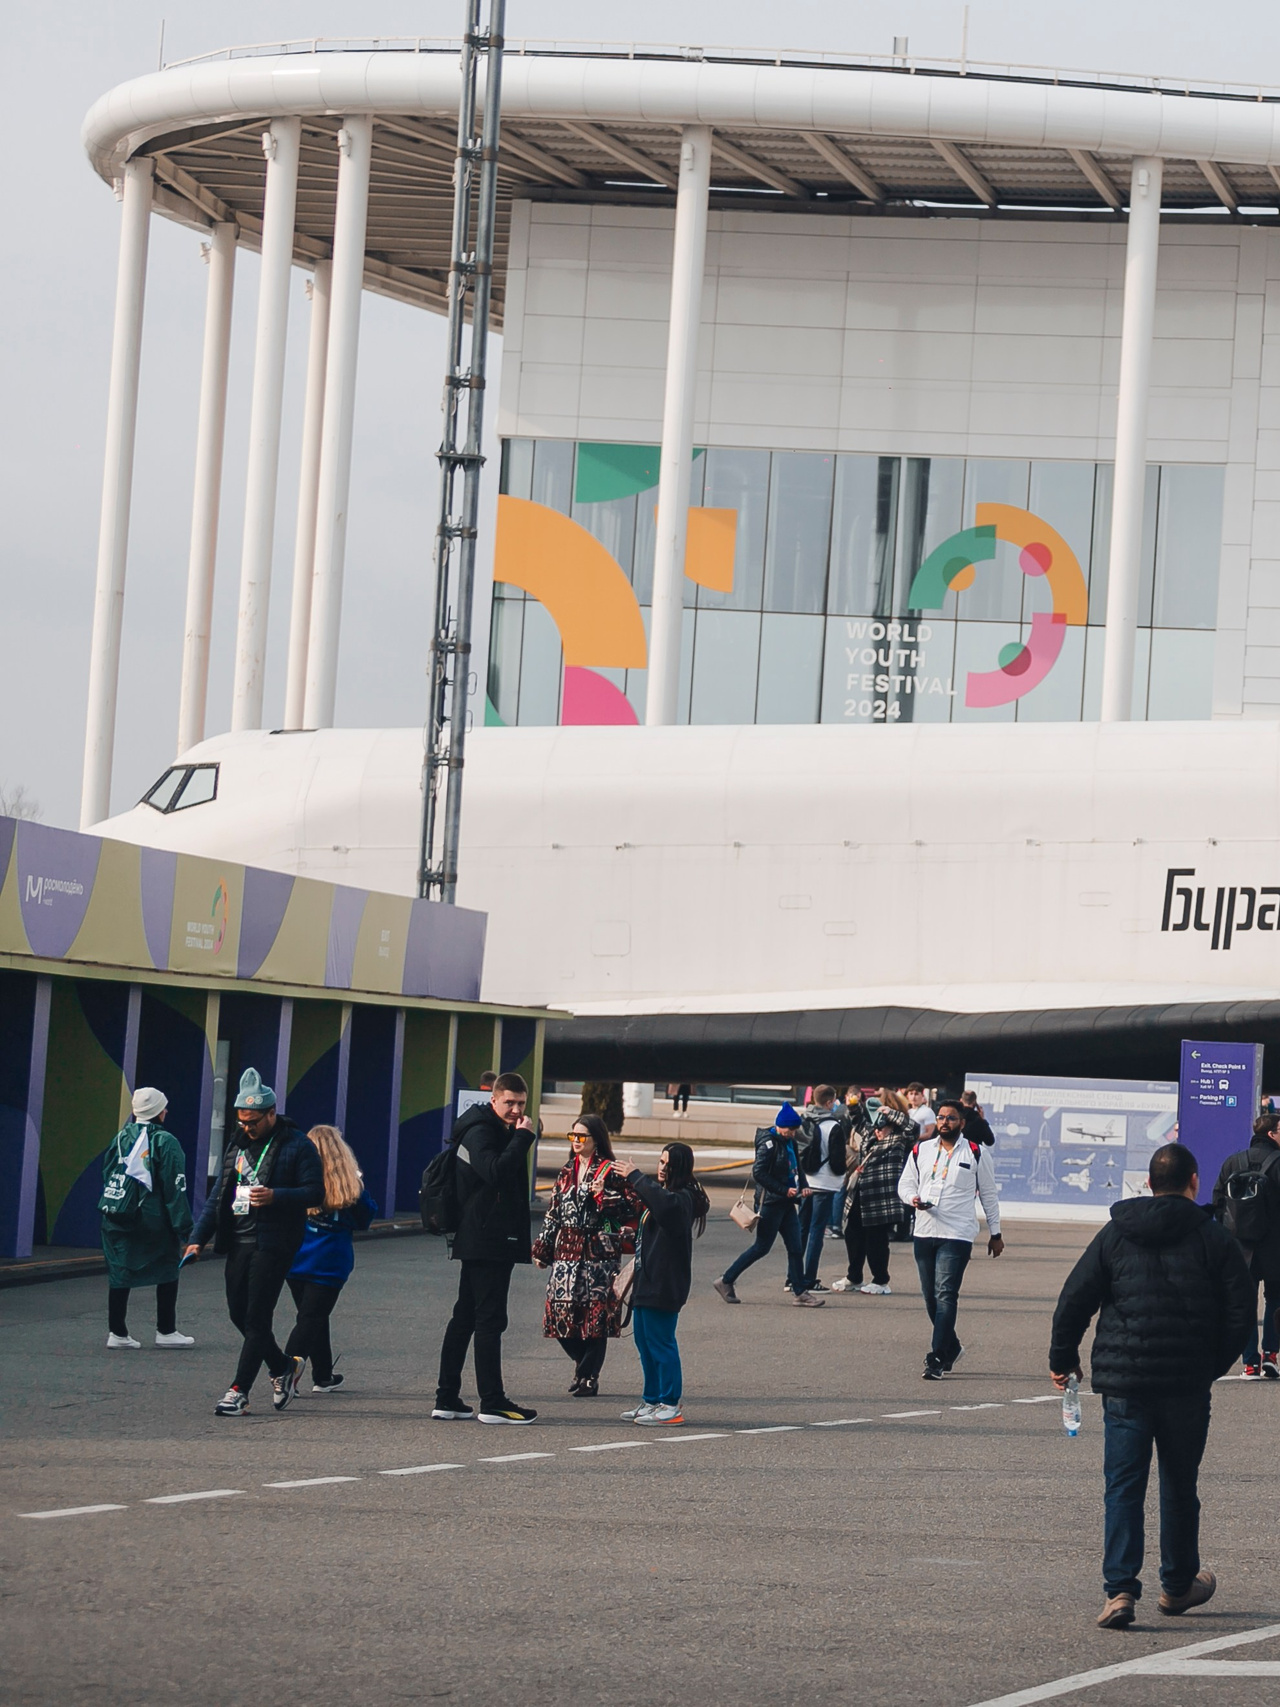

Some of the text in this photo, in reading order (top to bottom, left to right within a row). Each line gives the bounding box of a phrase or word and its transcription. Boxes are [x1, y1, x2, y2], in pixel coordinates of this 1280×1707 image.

[846, 622, 932, 642] WORLD
[845, 647, 926, 668] YOUTH
[846, 673, 958, 695] FESTIVAL
[844, 699, 901, 719] 2024
